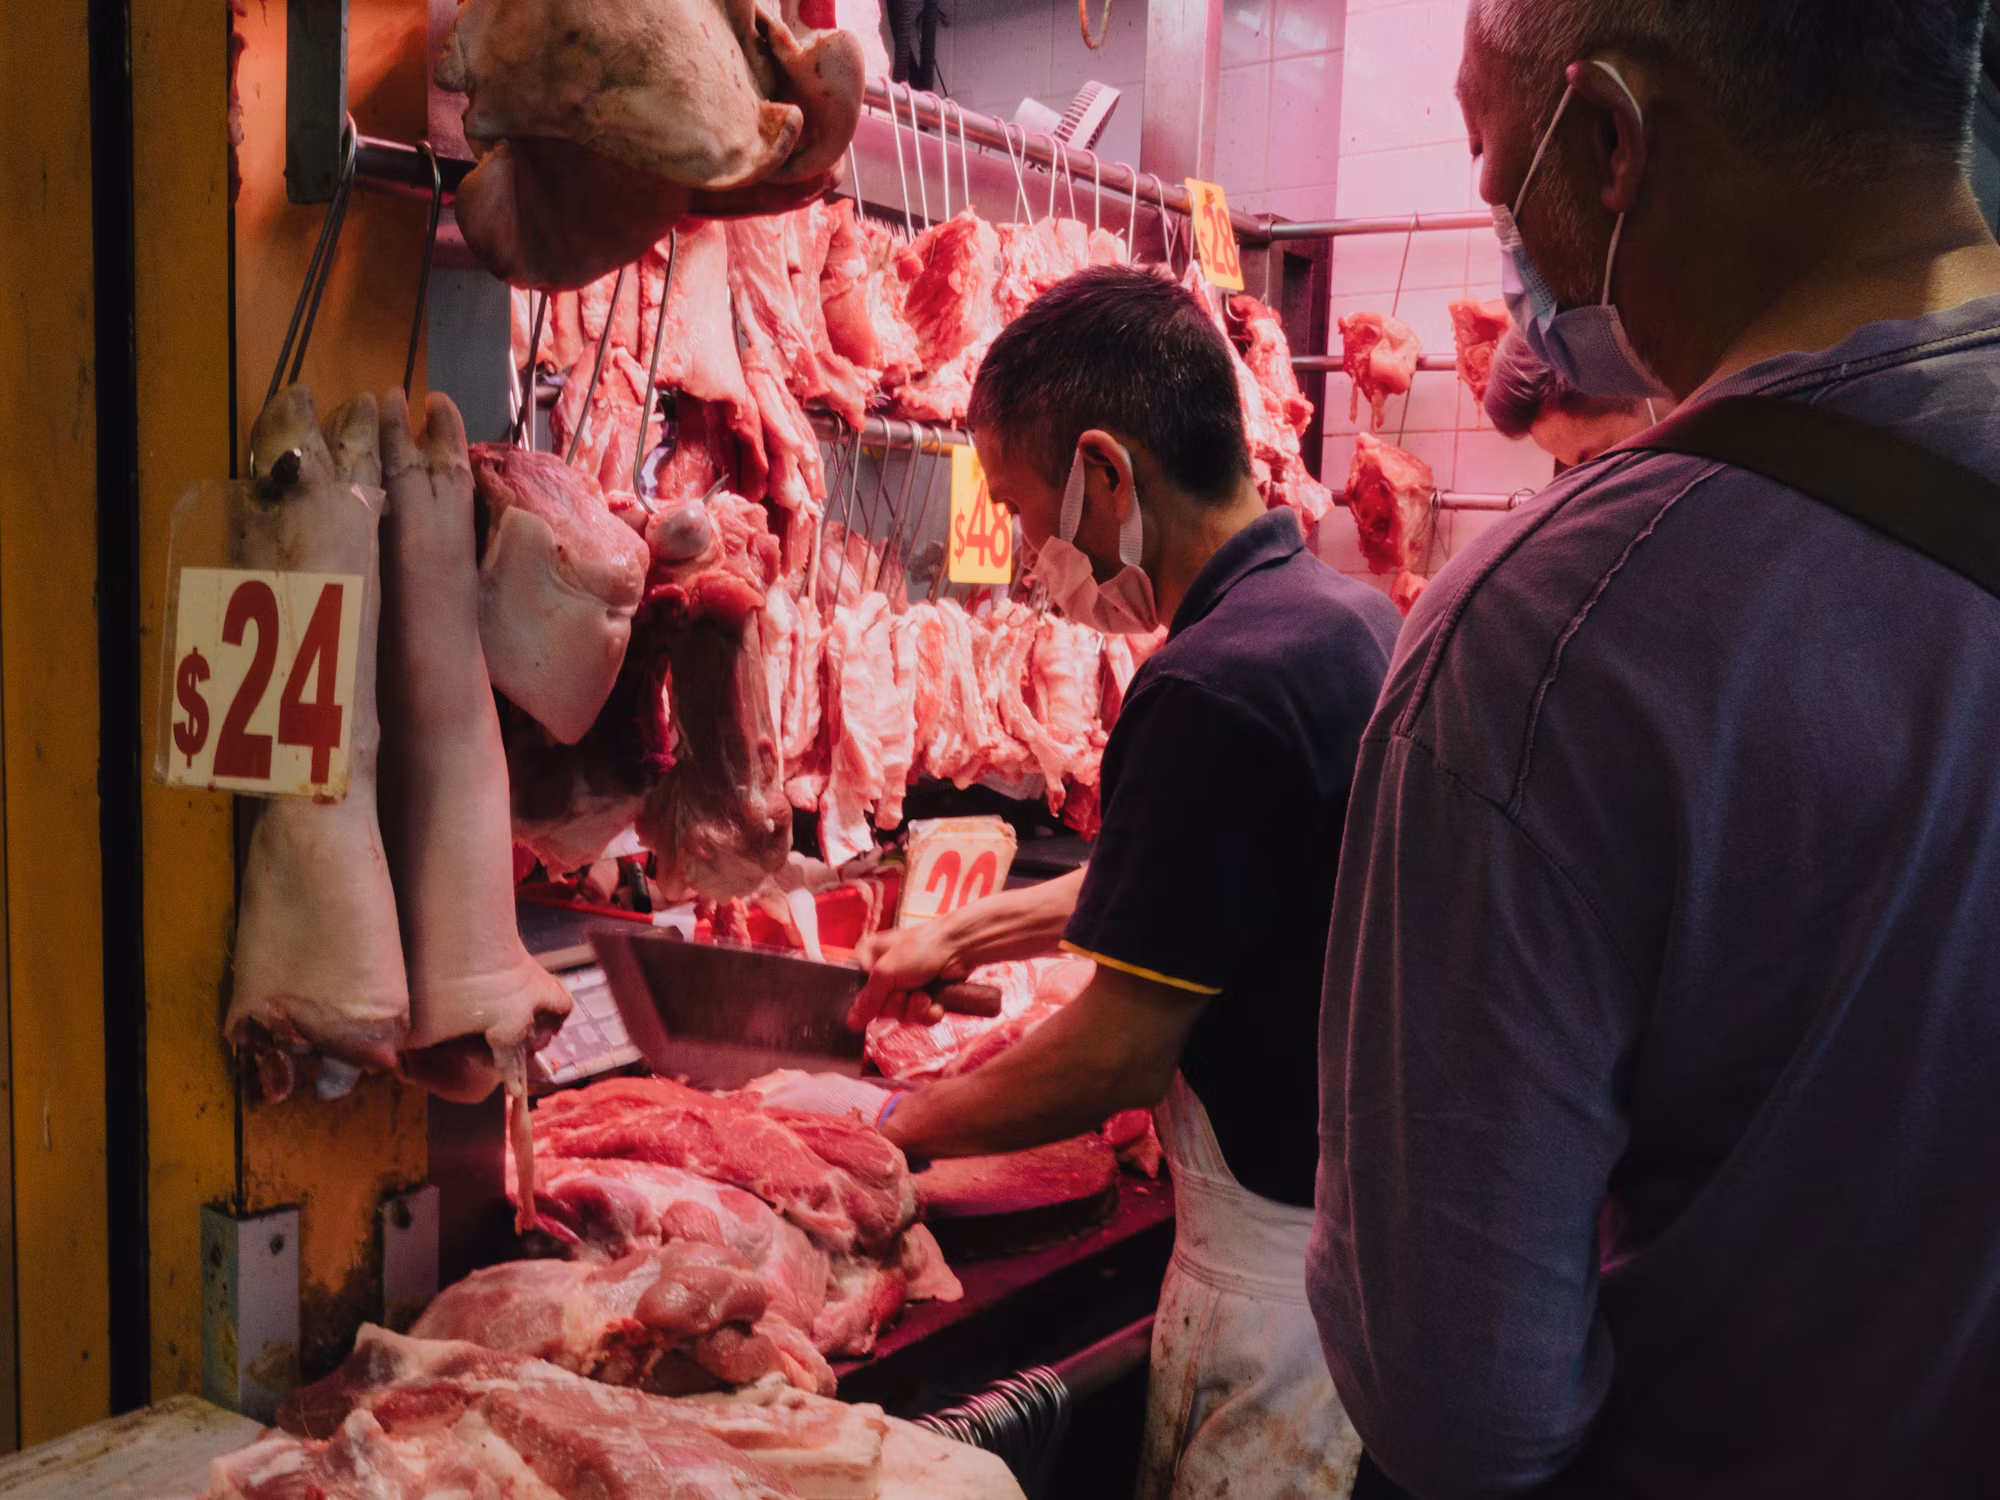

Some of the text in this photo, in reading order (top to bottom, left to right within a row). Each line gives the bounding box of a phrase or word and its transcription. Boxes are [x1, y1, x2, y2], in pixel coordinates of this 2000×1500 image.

[1200, 204, 1239, 278] $28
[954, 479, 1010, 568] $48
[173, 580, 344, 784] $24
